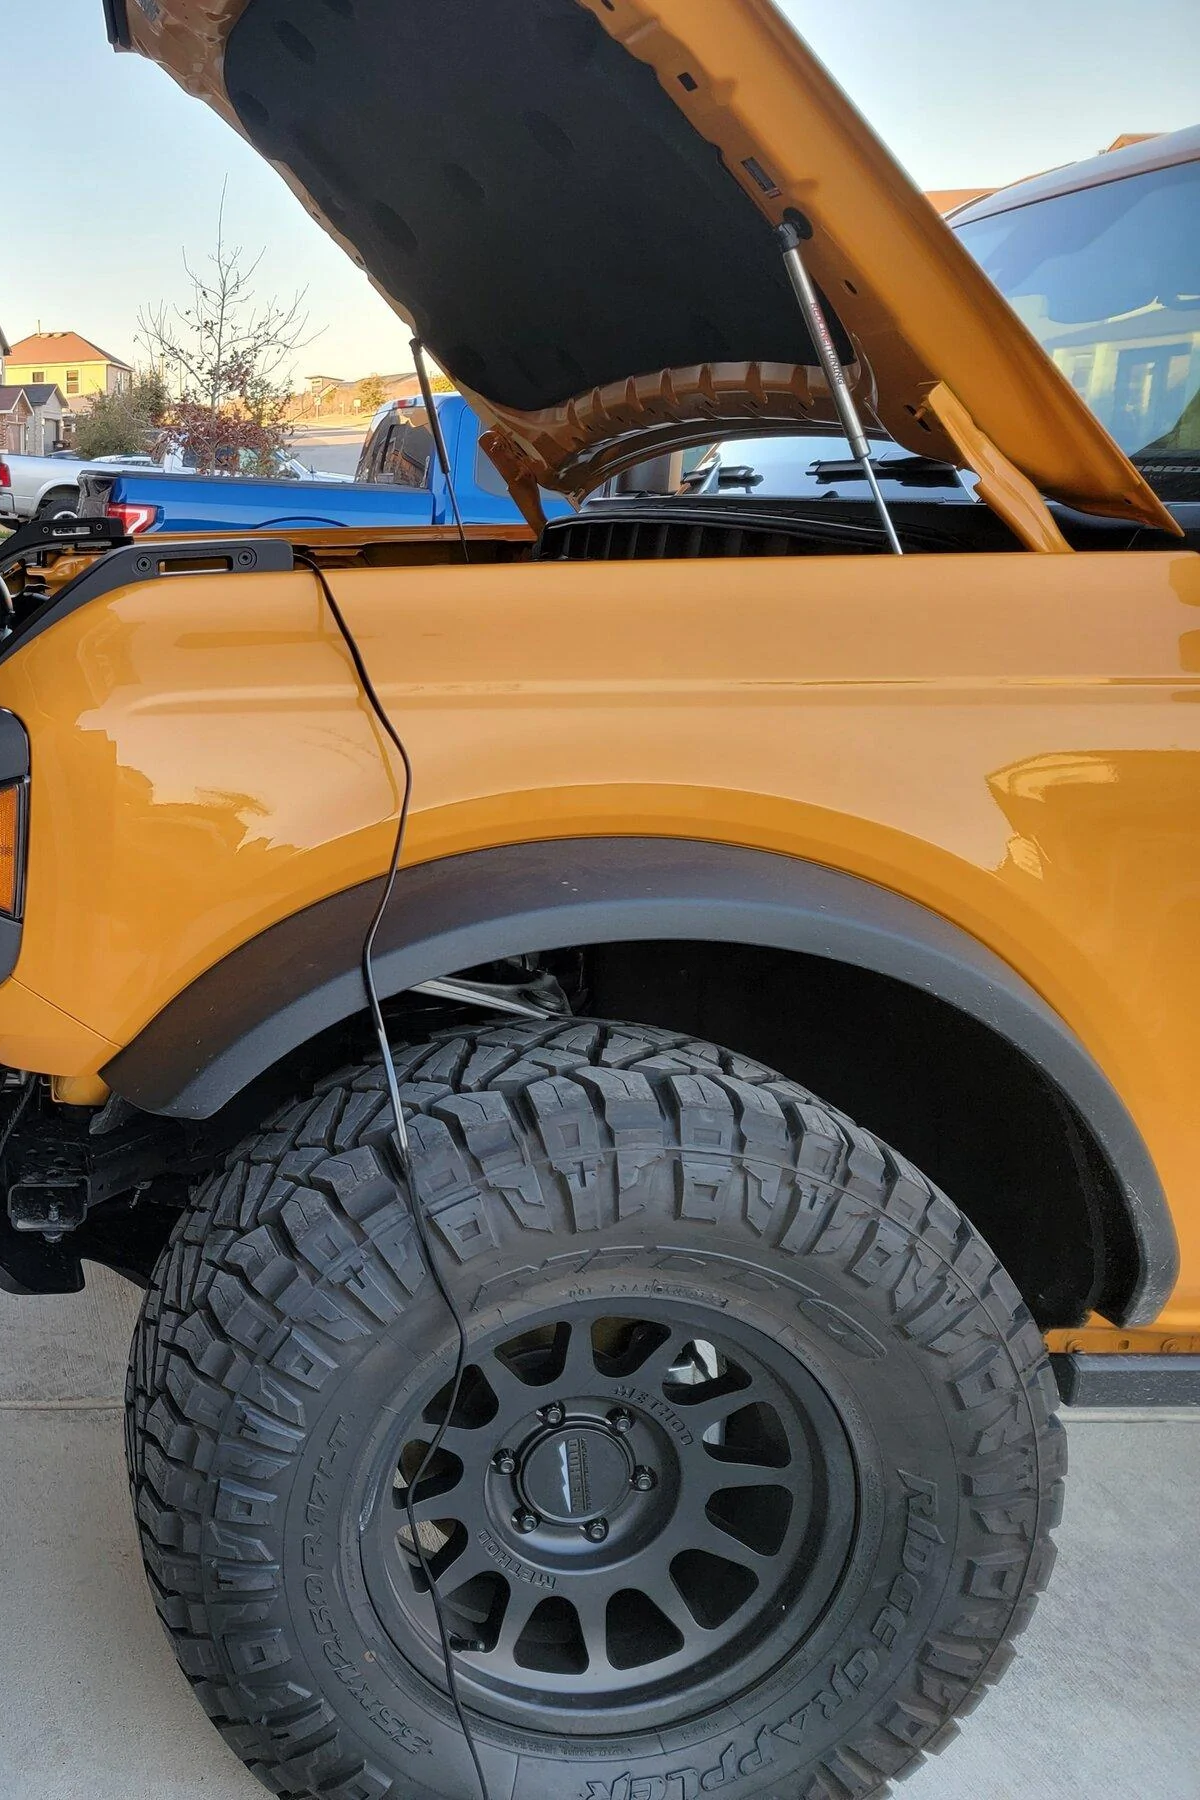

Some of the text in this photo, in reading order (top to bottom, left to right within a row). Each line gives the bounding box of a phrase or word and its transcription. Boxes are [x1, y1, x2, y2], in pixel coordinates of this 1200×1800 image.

[1136, 465, 1200, 473] NCO
[609, 1383, 695, 1447] METHOD
[477, 1527, 557, 1590] METHOD
[870, 1469, 947, 1652] RIDGE
[585, 1647, 880, 1800] GRAPPLER
